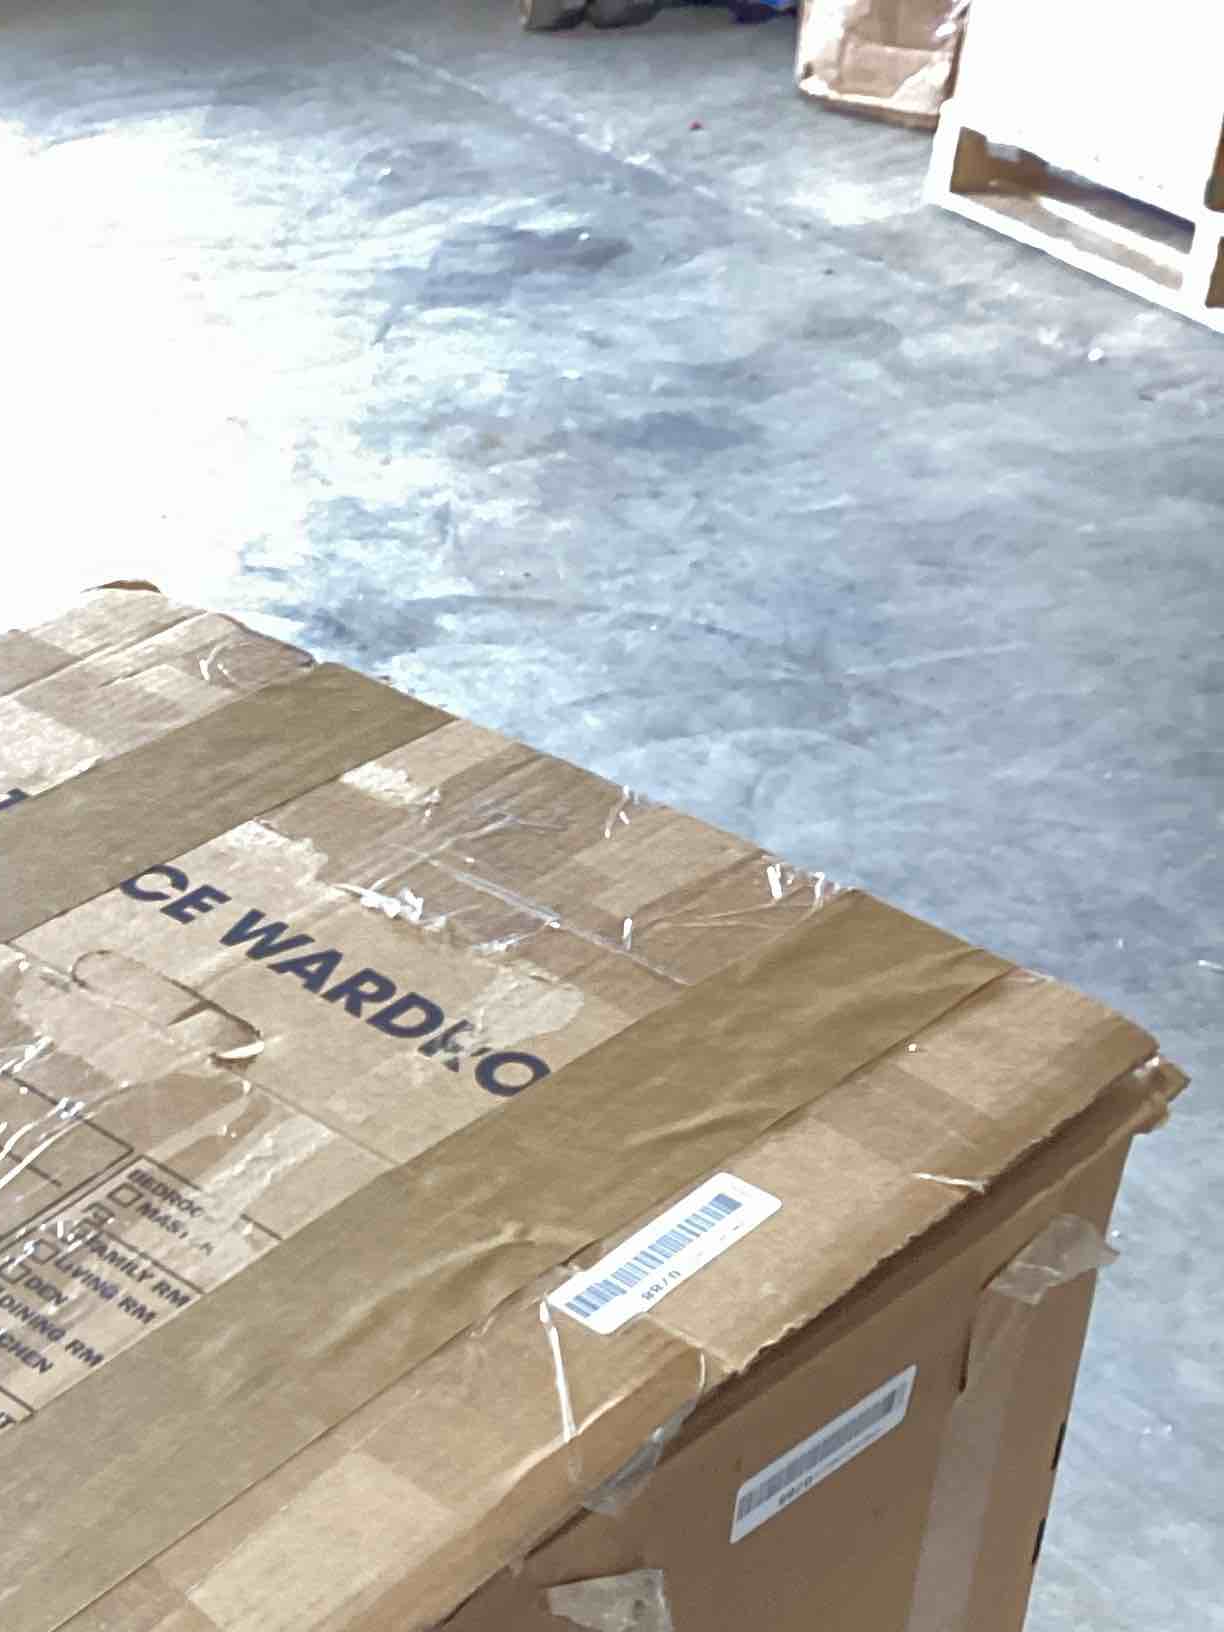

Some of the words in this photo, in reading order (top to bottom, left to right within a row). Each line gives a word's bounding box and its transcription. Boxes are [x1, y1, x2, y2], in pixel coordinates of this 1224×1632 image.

[127, 1168, 206, 1218] BEDROO
[23, 1274, 69, 1306] DEN
[54, 1254, 120, 1301] LIVING
[117, 1294, 158, 1325] RM
[151, 1280, 192, 1308] RM
[64, 1339, 105, 1368] RM
